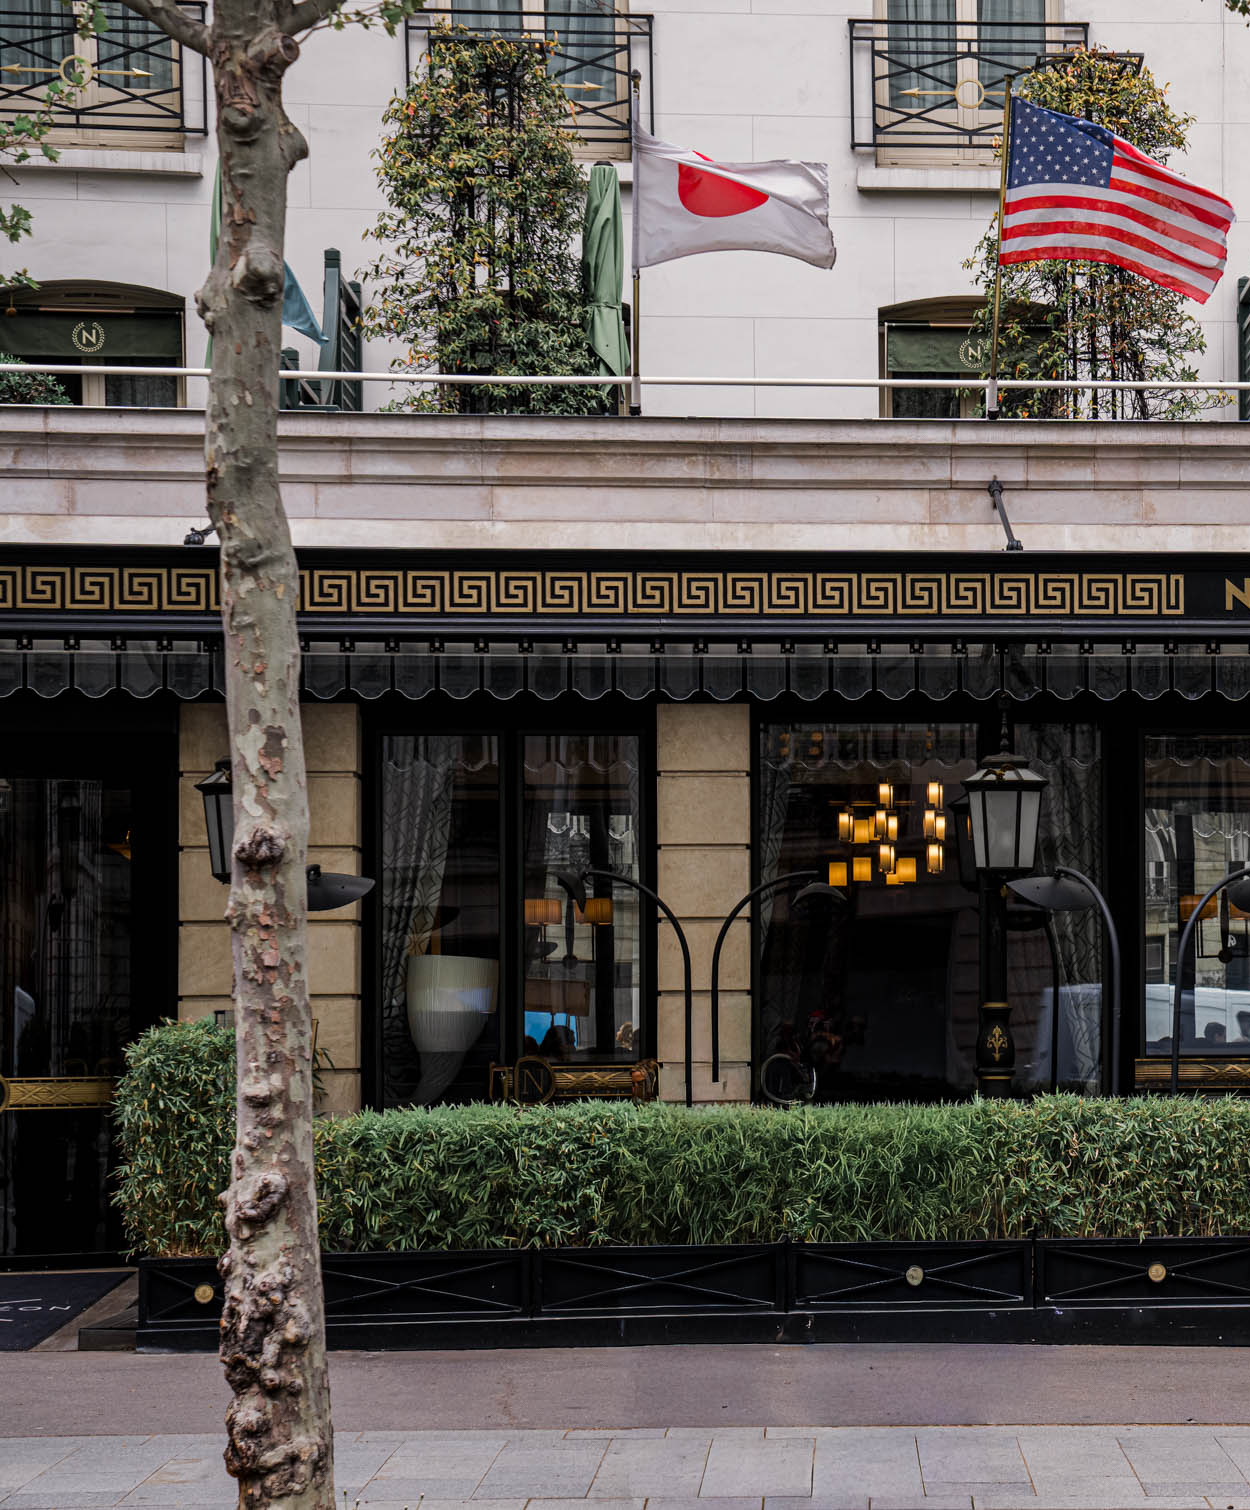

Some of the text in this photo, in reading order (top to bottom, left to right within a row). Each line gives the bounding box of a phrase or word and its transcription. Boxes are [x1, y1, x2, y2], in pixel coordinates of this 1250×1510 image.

[81, 329, 97, 345] N
[968, 346, 981, 360] N
[520, 1067, 544, 1095] N
